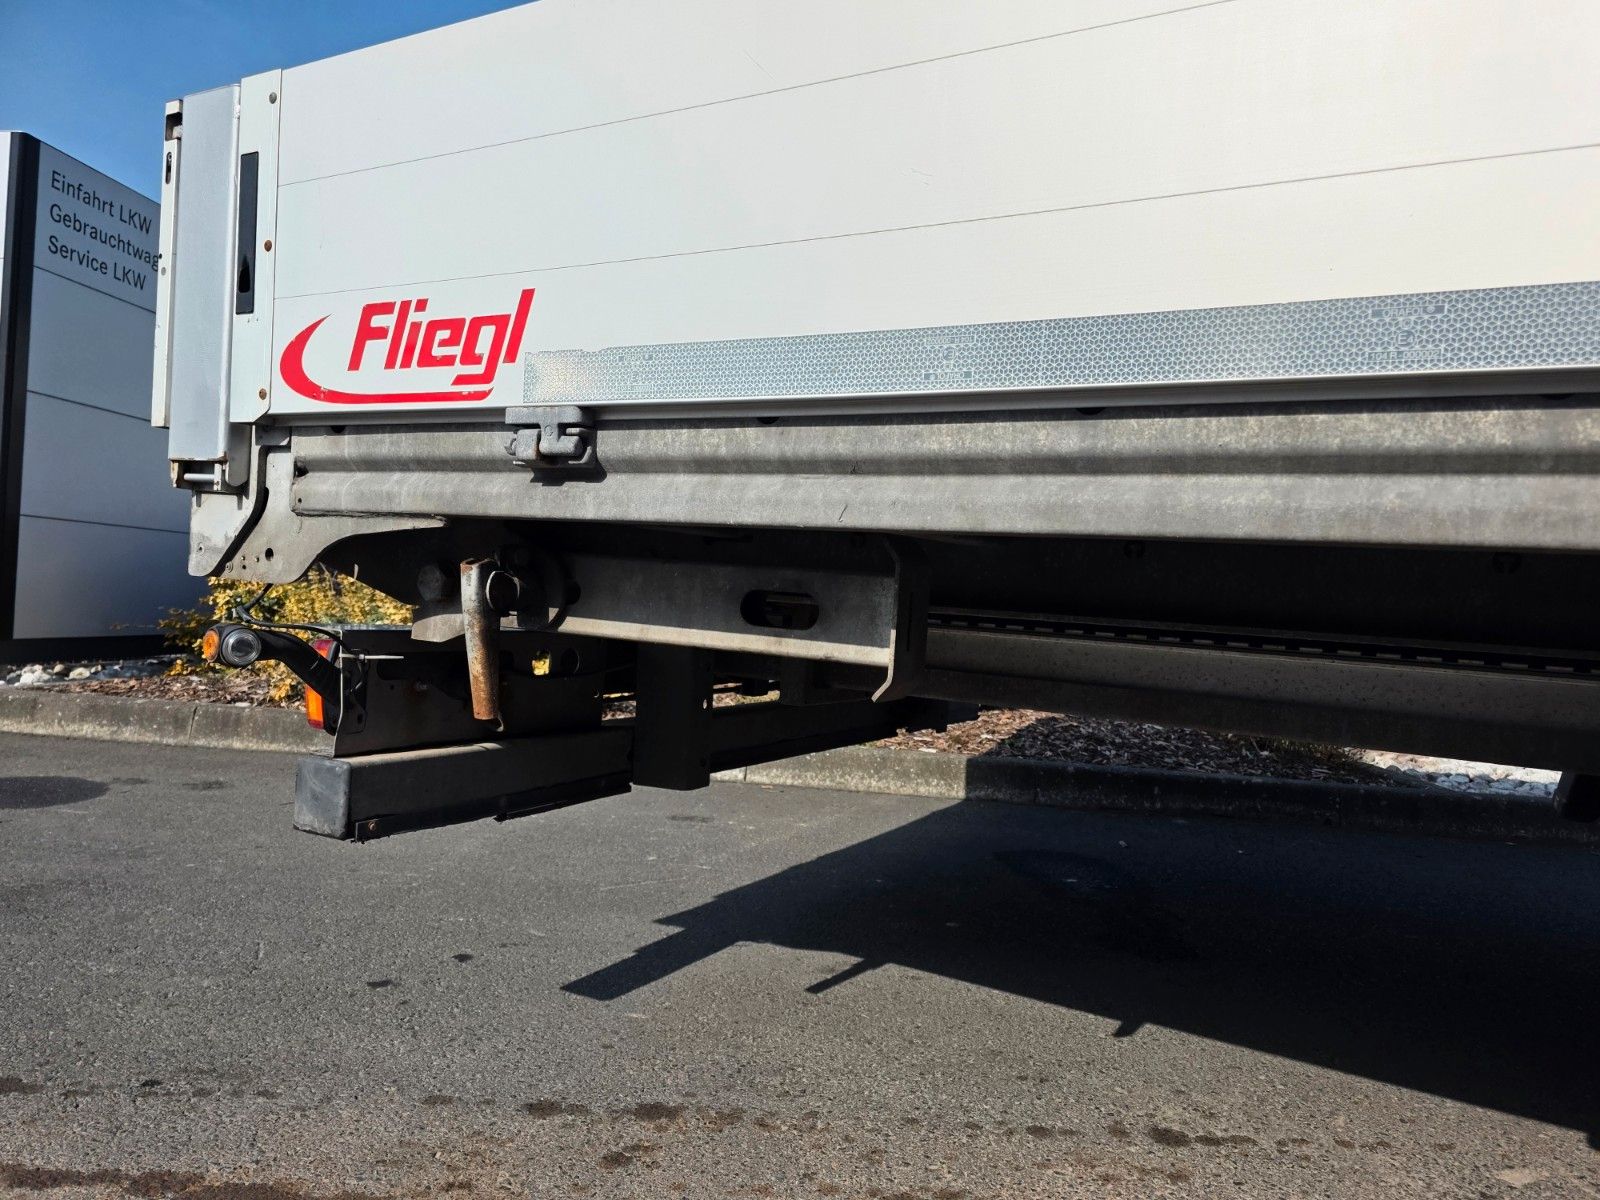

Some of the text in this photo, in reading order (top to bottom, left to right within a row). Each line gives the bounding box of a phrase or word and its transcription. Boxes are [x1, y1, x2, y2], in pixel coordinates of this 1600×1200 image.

[51, 170, 152, 235] Einfahrt LKW
[48, 235, 147, 291] Service LKW
[50, 203, 158, 272] Gebrauchtwag
[347, 288, 535, 386] Fliegl
[1397, 332, 1414, 345] E4
